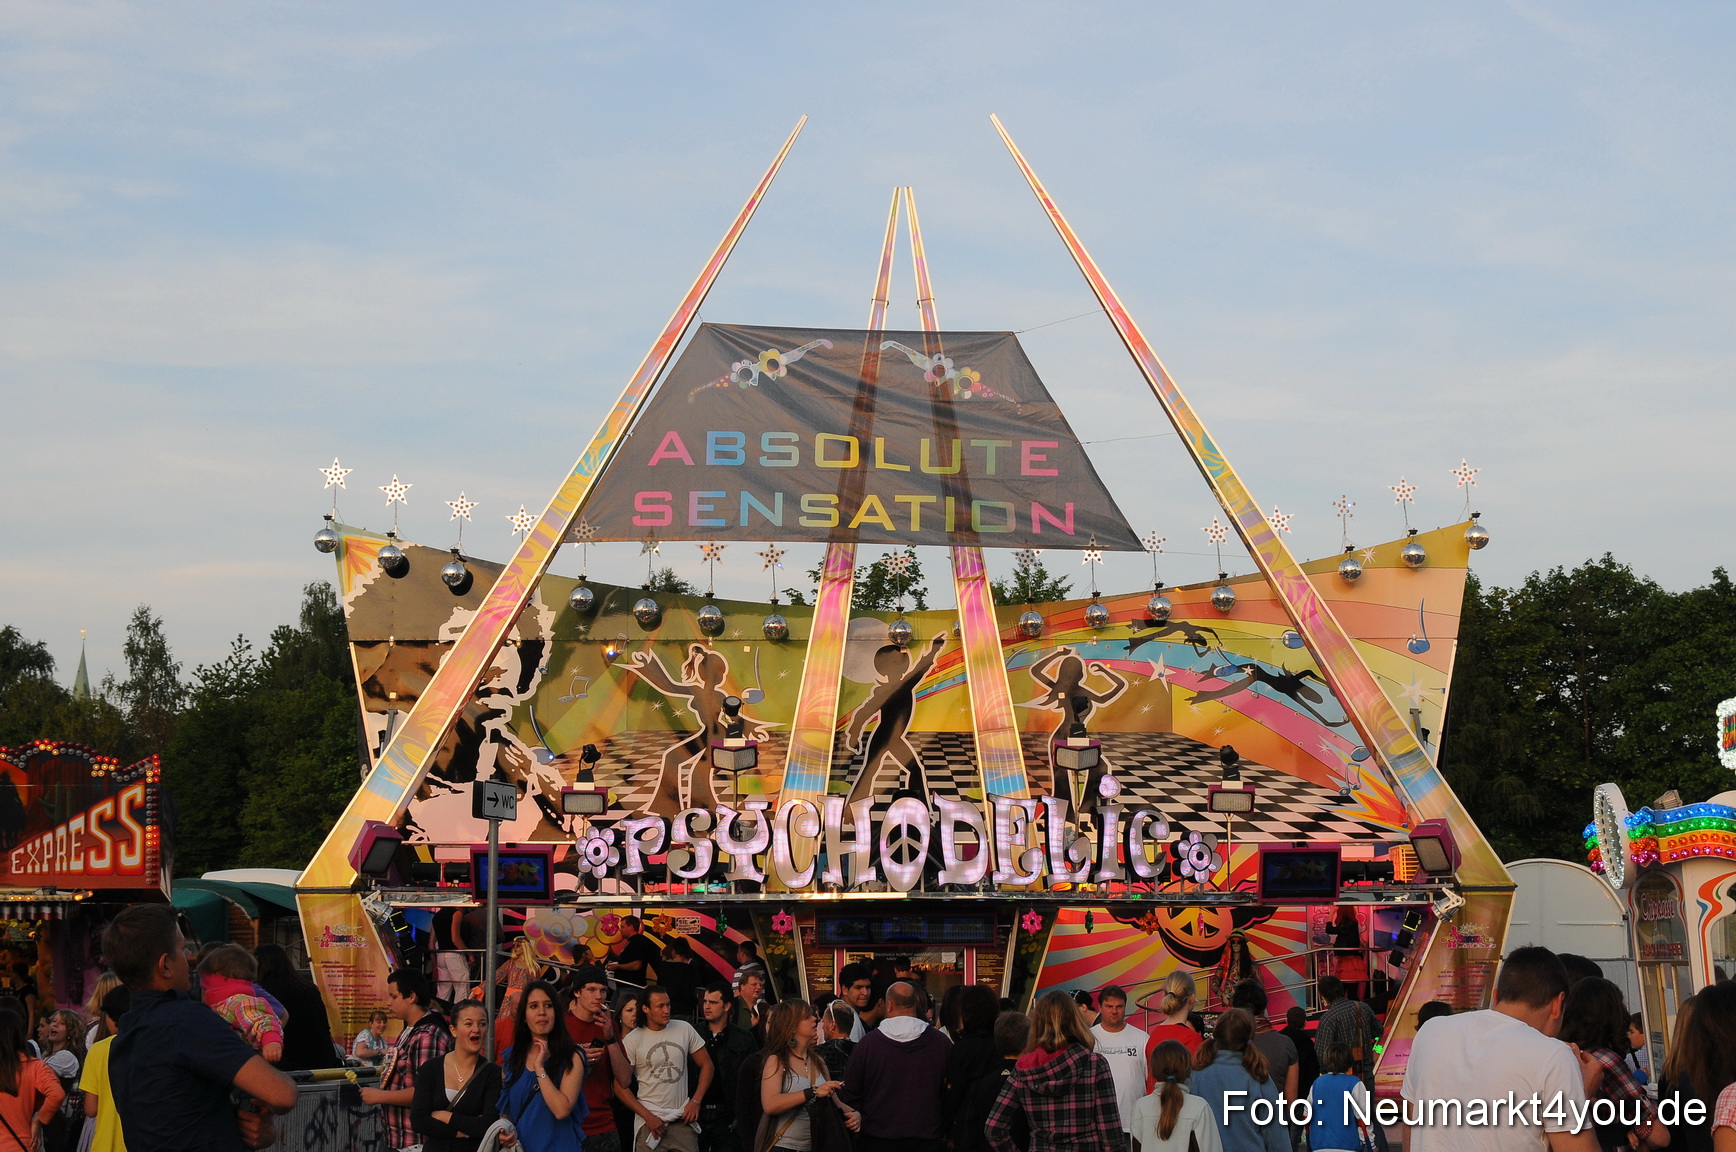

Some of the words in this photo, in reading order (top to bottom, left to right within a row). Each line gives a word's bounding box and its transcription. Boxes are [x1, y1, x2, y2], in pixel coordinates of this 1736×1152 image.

[647, 431, 1060, 477] ABSOLUTE
[632, 490, 1076, 535] SENSATION
[501, 794, 515, 809] WC
[11, 782, 144, 875] EXPRESS
[621, 775, 1169, 891] PSYCHODELIC
[1127, 1048, 1137, 1056] 52
